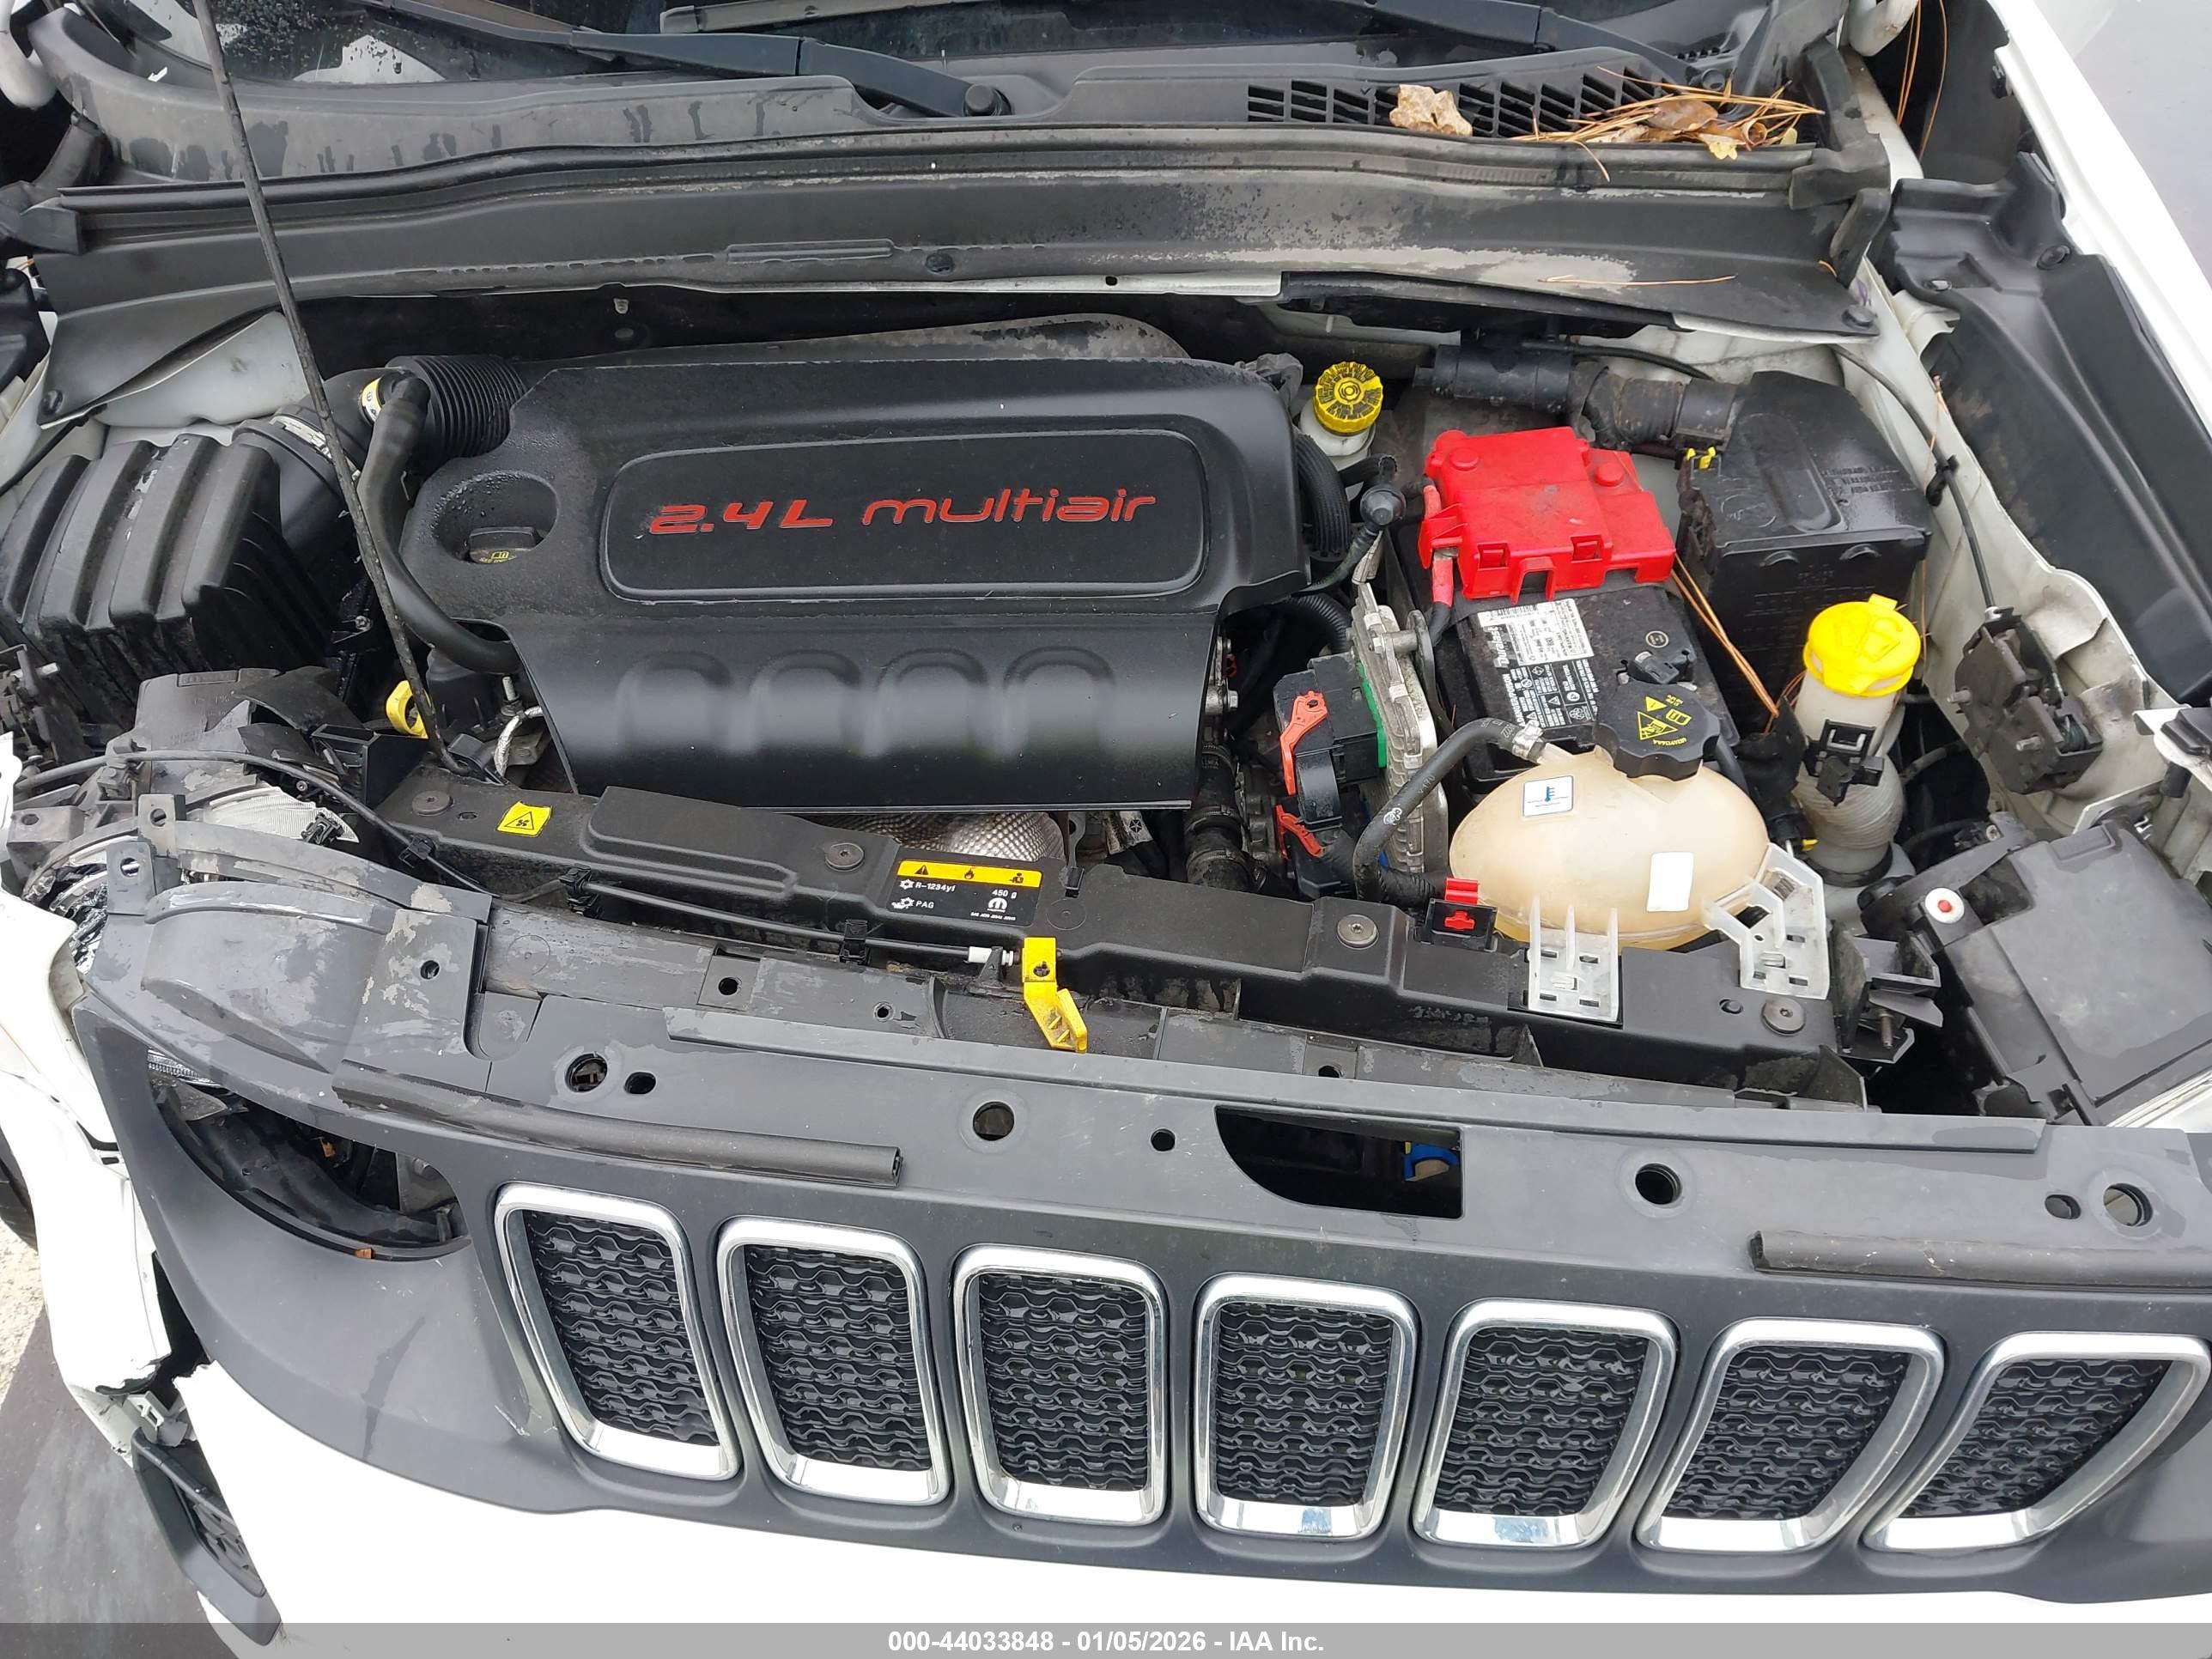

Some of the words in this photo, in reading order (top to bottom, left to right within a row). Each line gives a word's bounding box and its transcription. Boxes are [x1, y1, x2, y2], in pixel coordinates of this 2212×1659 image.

[862, 489, 1155, 524] multiair
[1487, 626, 1510, 668] Duralast
[915, 881, 957, 893] R-1234yf
[991, 889, 1009, 898] 450
[915, 900, 934, 909] PAG
